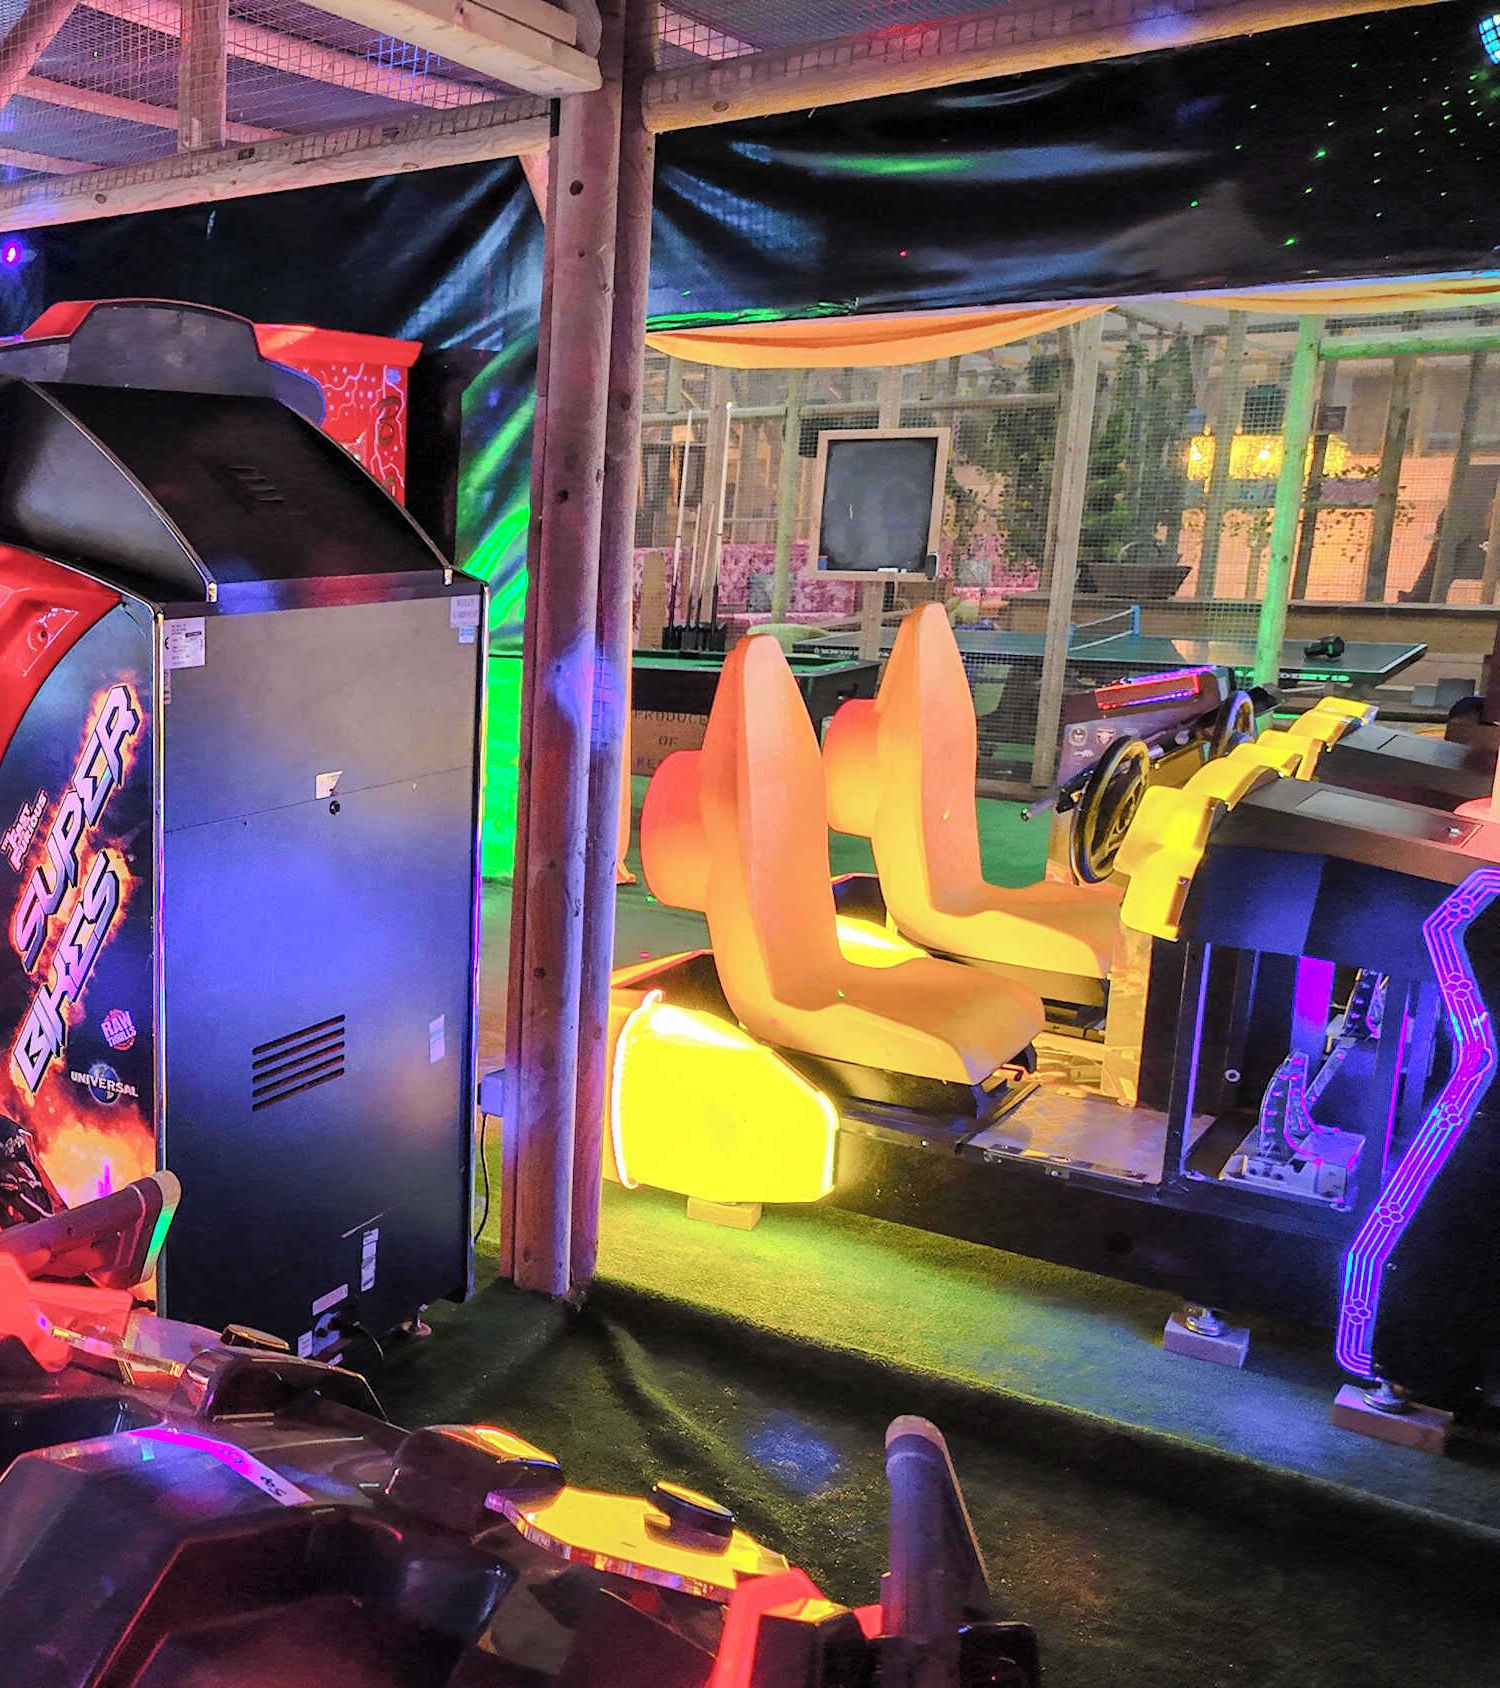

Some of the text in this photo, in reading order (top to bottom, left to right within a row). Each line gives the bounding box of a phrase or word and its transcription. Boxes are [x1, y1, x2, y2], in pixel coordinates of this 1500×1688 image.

[658, 735, 677, 747] OF
[15, 685, 140, 974] SUPER
[13, 850, 120, 1093] BIKES
[101, 1010, 132, 1039] RAW
[70, 1070, 139, 1098] UNIVERSAL
